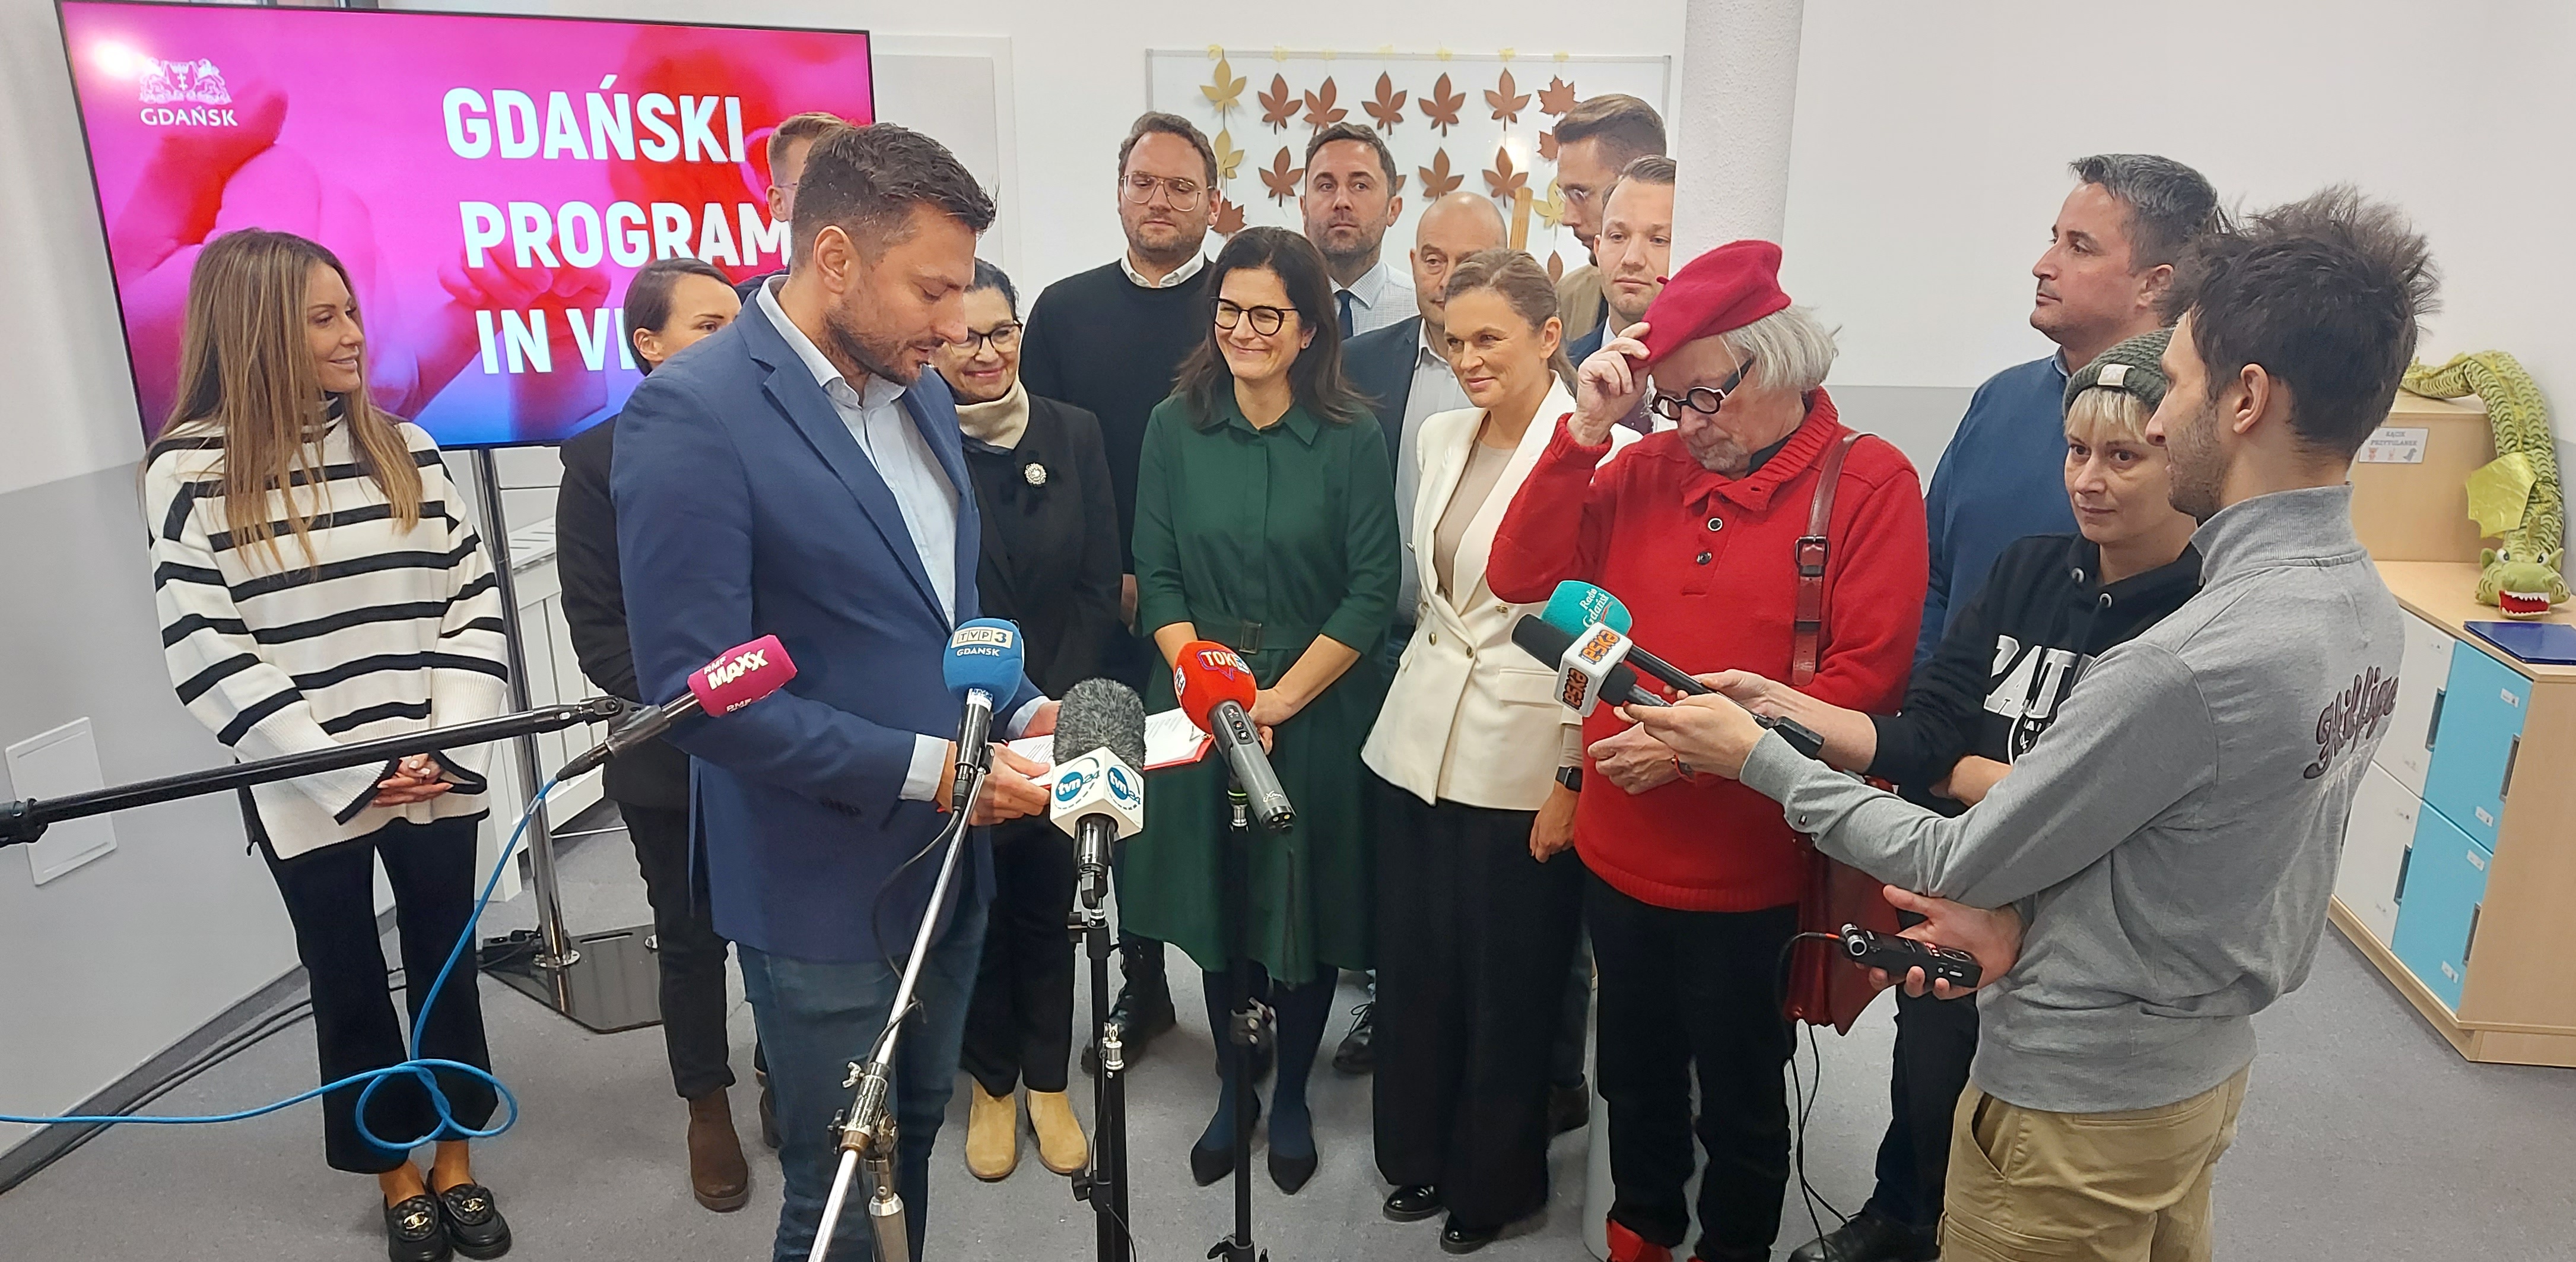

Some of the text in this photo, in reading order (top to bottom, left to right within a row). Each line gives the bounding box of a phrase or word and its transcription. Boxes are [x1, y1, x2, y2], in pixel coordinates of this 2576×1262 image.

[139, 105, 239, 126] GDAŃSK
[442, 74, 746, 162] GDAŃSKI
[459, 201, 792, 268] PROGRAM
[475, 309, 552, 374] IN
[703, 656, 727, 675] RMF
[707, 649, 768, 690] MAXX
[1058, 778, 1081, 795] tvn
[1109, 771, 1127, 795] tvn
